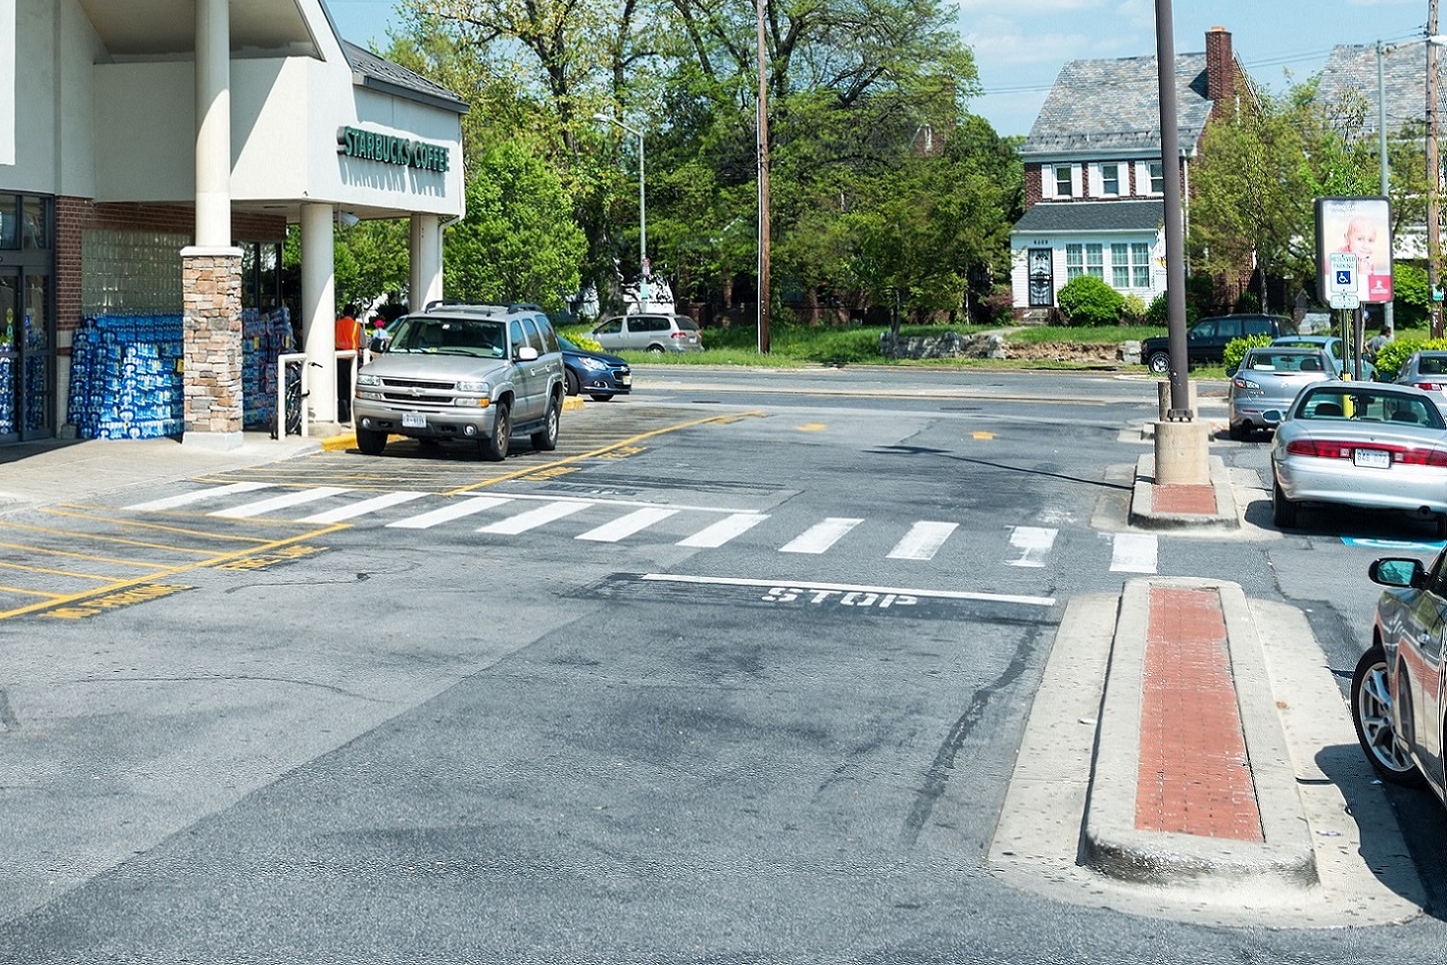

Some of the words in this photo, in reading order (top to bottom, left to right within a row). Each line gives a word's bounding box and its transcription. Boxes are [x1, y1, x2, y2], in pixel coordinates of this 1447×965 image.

[338, 126, 411, 167] STARBUCKS
[413, 140, 450, 172] COFFEE
[761, 587, 918, 608] STOP
